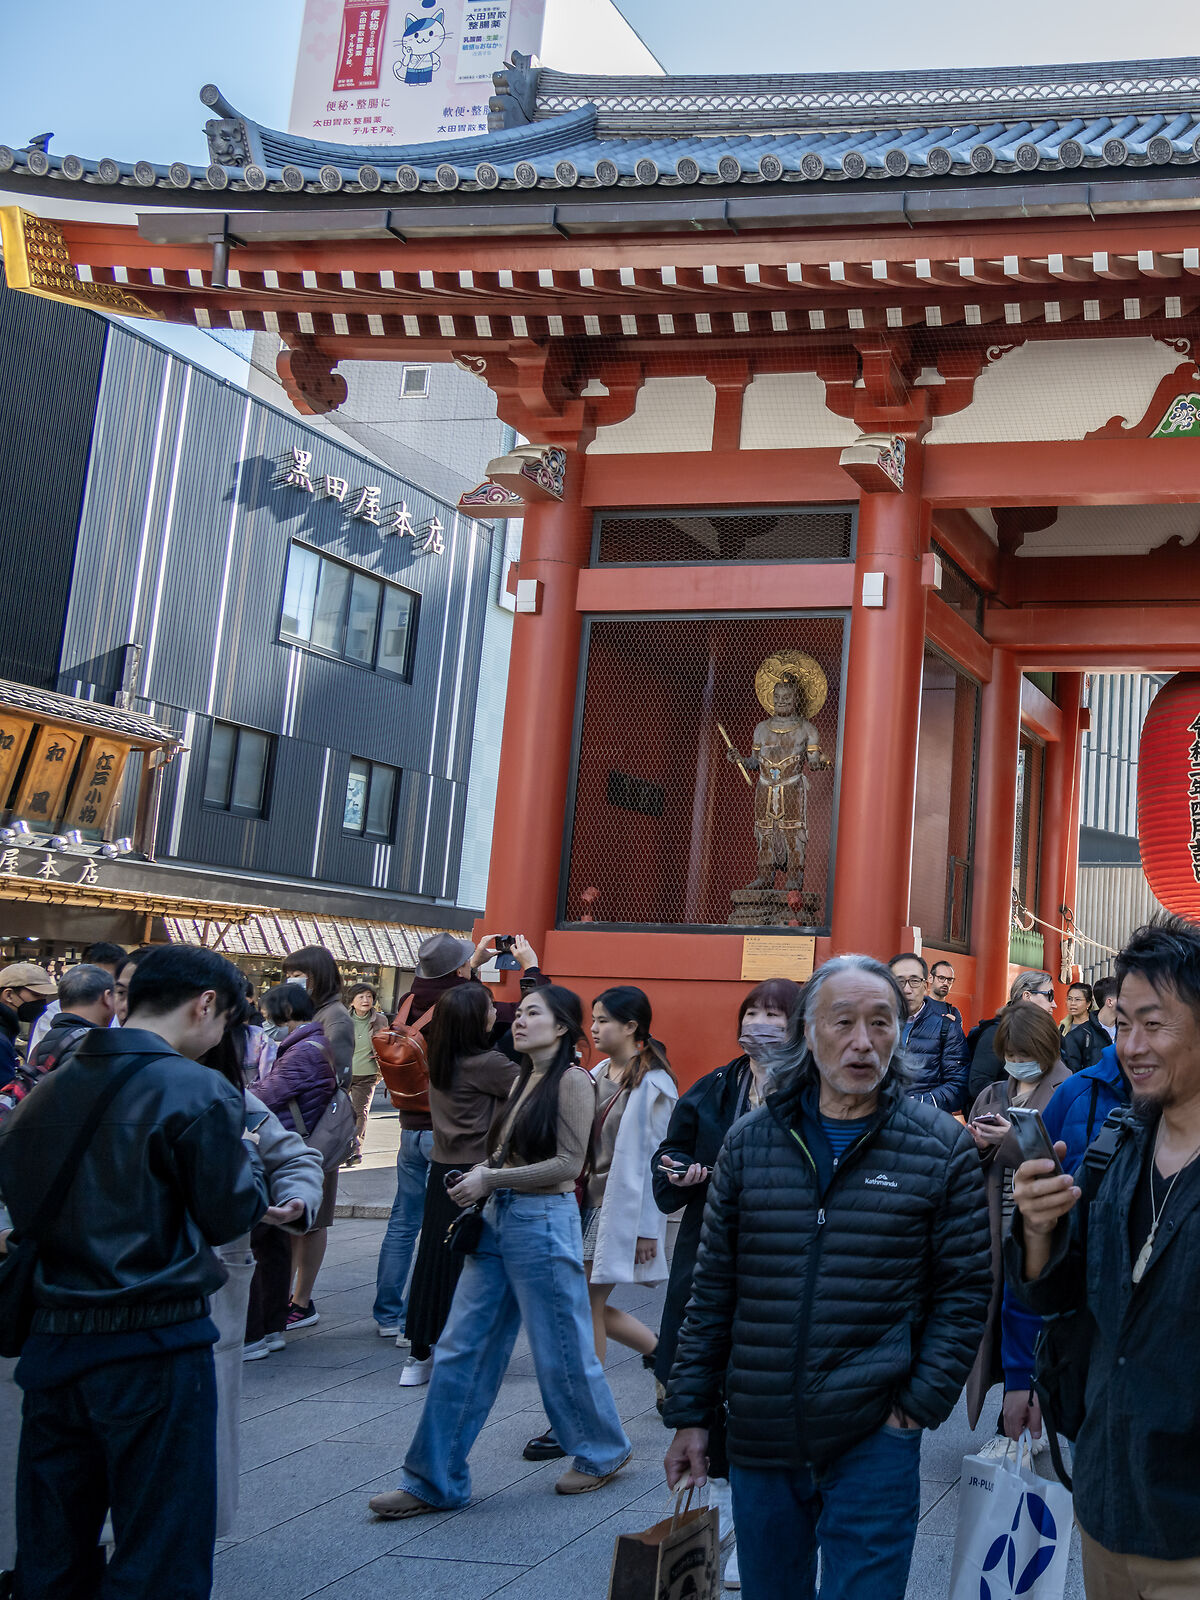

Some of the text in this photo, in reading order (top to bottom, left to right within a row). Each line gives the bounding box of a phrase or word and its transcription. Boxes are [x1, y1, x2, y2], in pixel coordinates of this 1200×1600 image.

[285, 446, 446, 556] 黒田屋本店
[864, 1177, 898, 1188] Kathmandu
